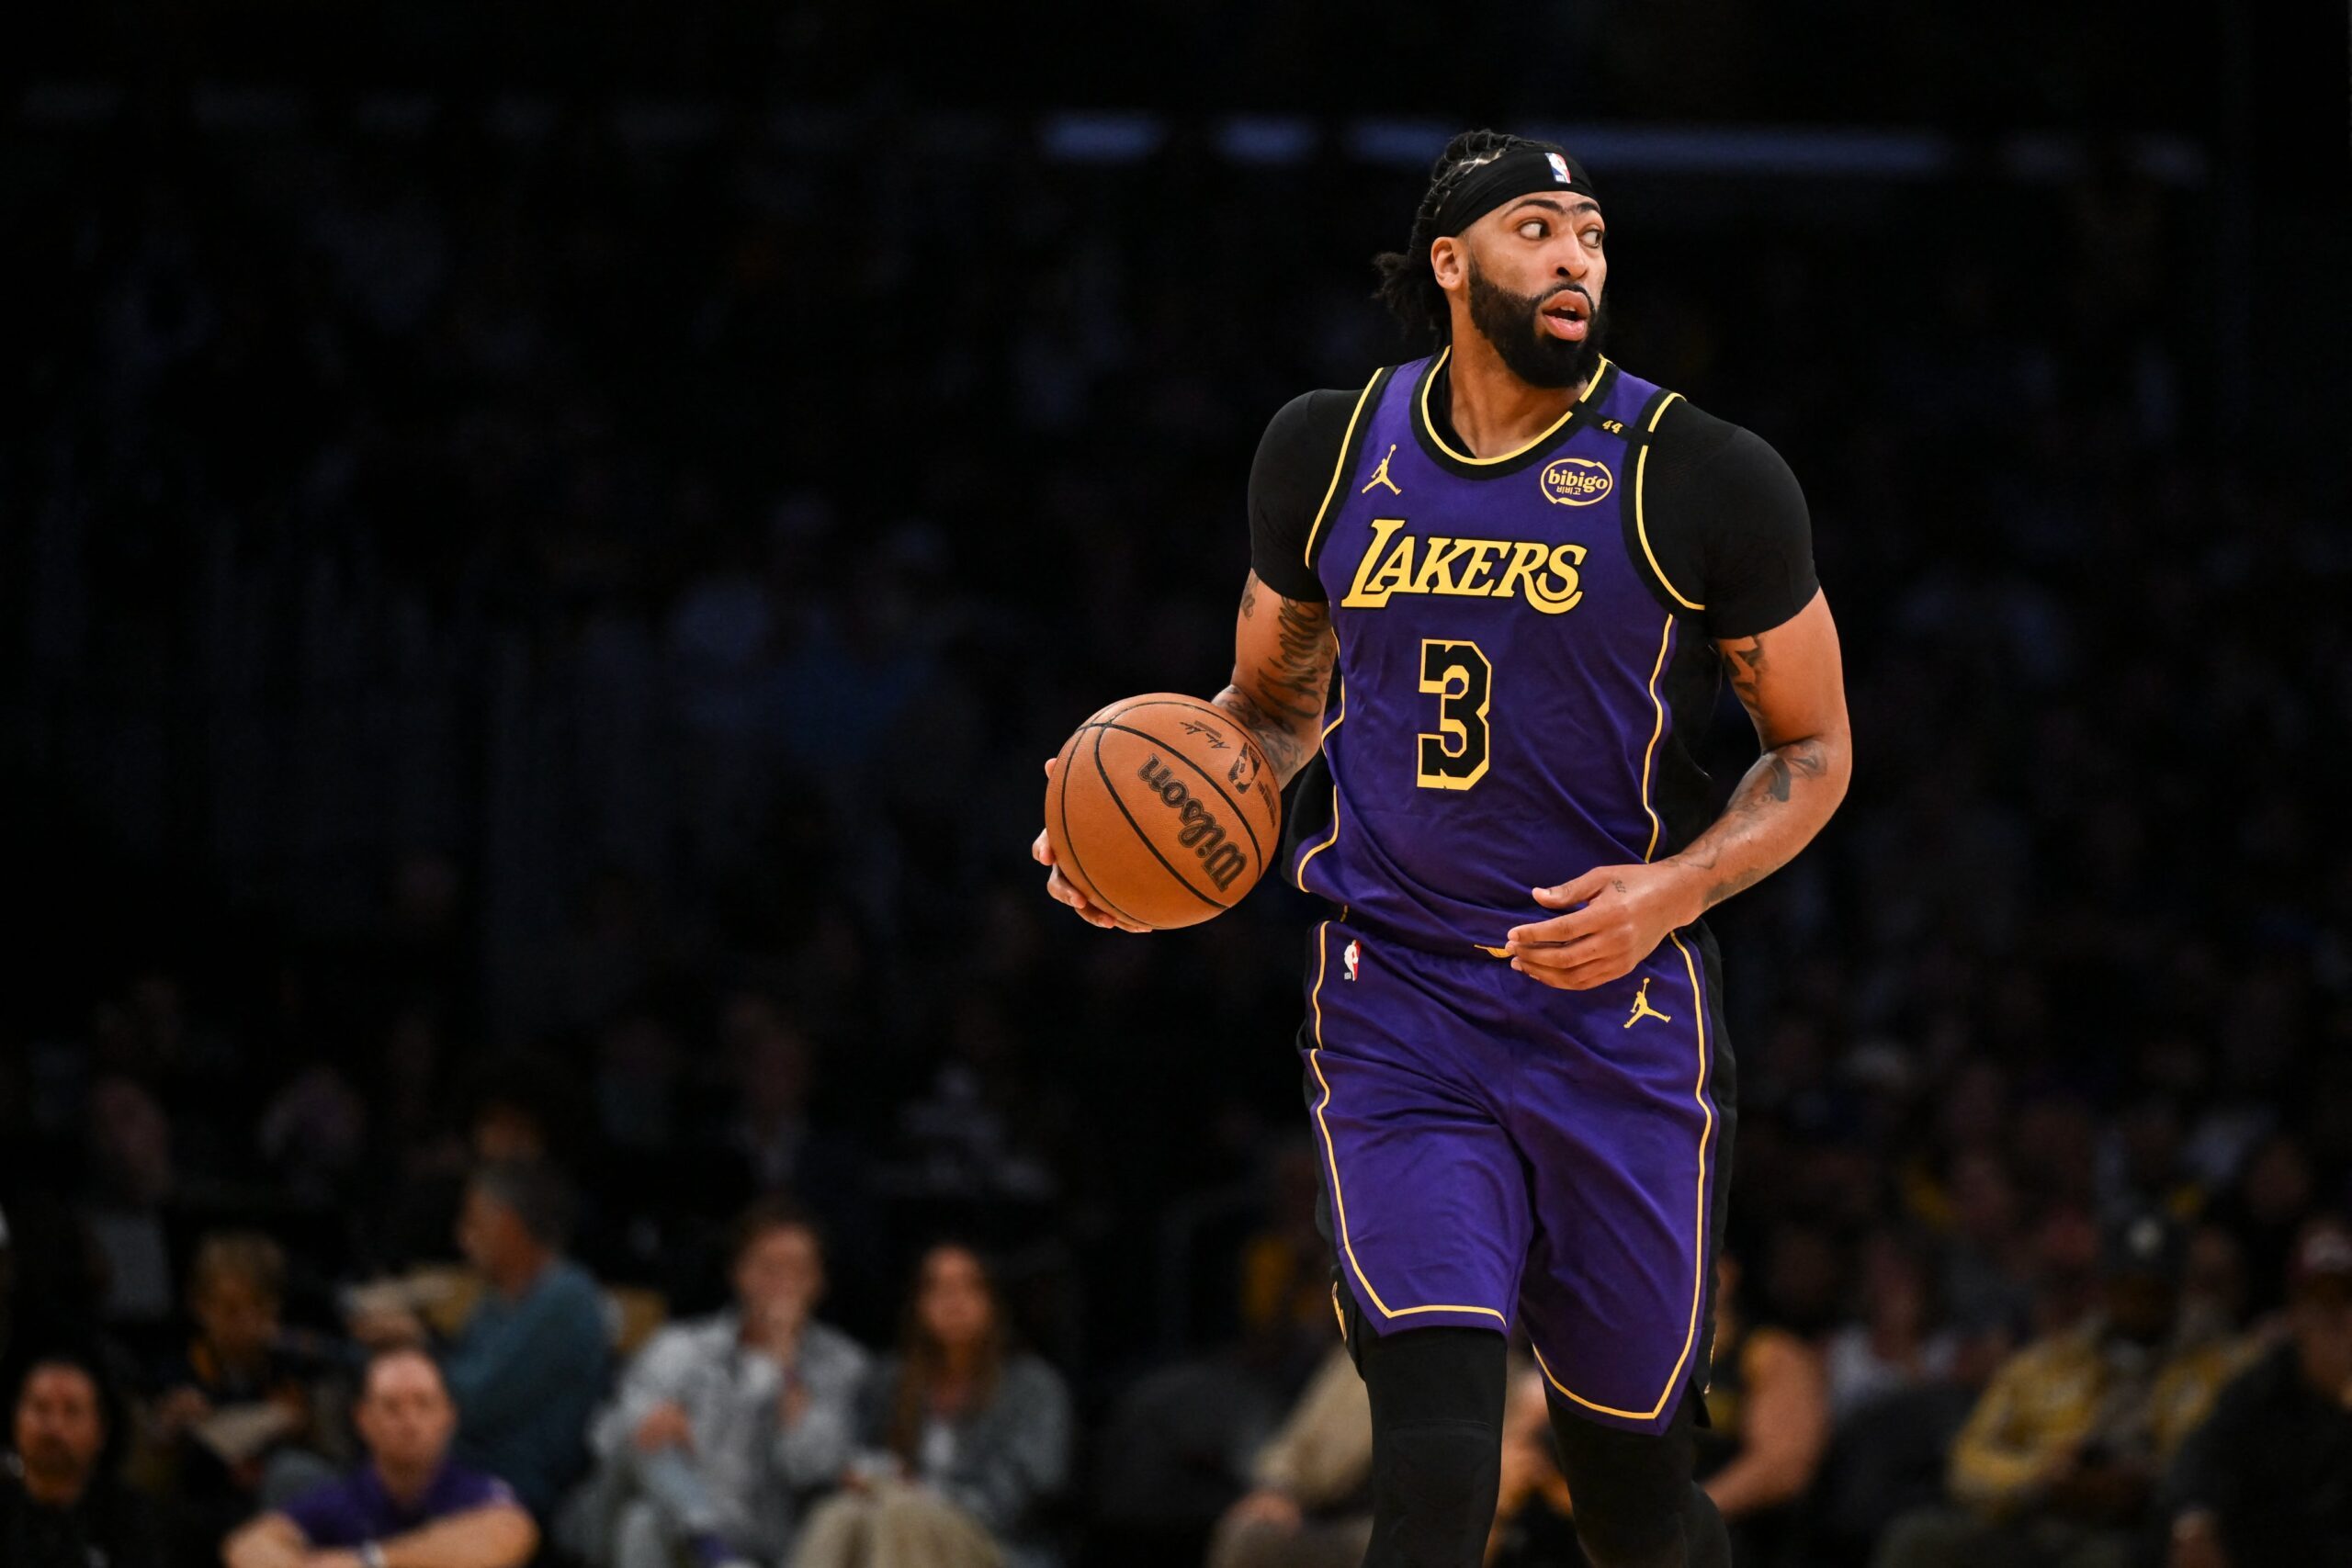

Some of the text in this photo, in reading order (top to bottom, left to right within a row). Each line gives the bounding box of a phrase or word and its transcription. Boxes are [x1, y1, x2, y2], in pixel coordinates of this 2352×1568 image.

[1602, 420, 1623, 434] 44
[1548, 469, 1608, 493] bibigo
[1556, 486, 1581, 495] 비비고
[1340, 517, 1589, 615] LAKERS
[1416, 637, 1493, 792] 3
[1138, 753, 1247, 892] Wilson
